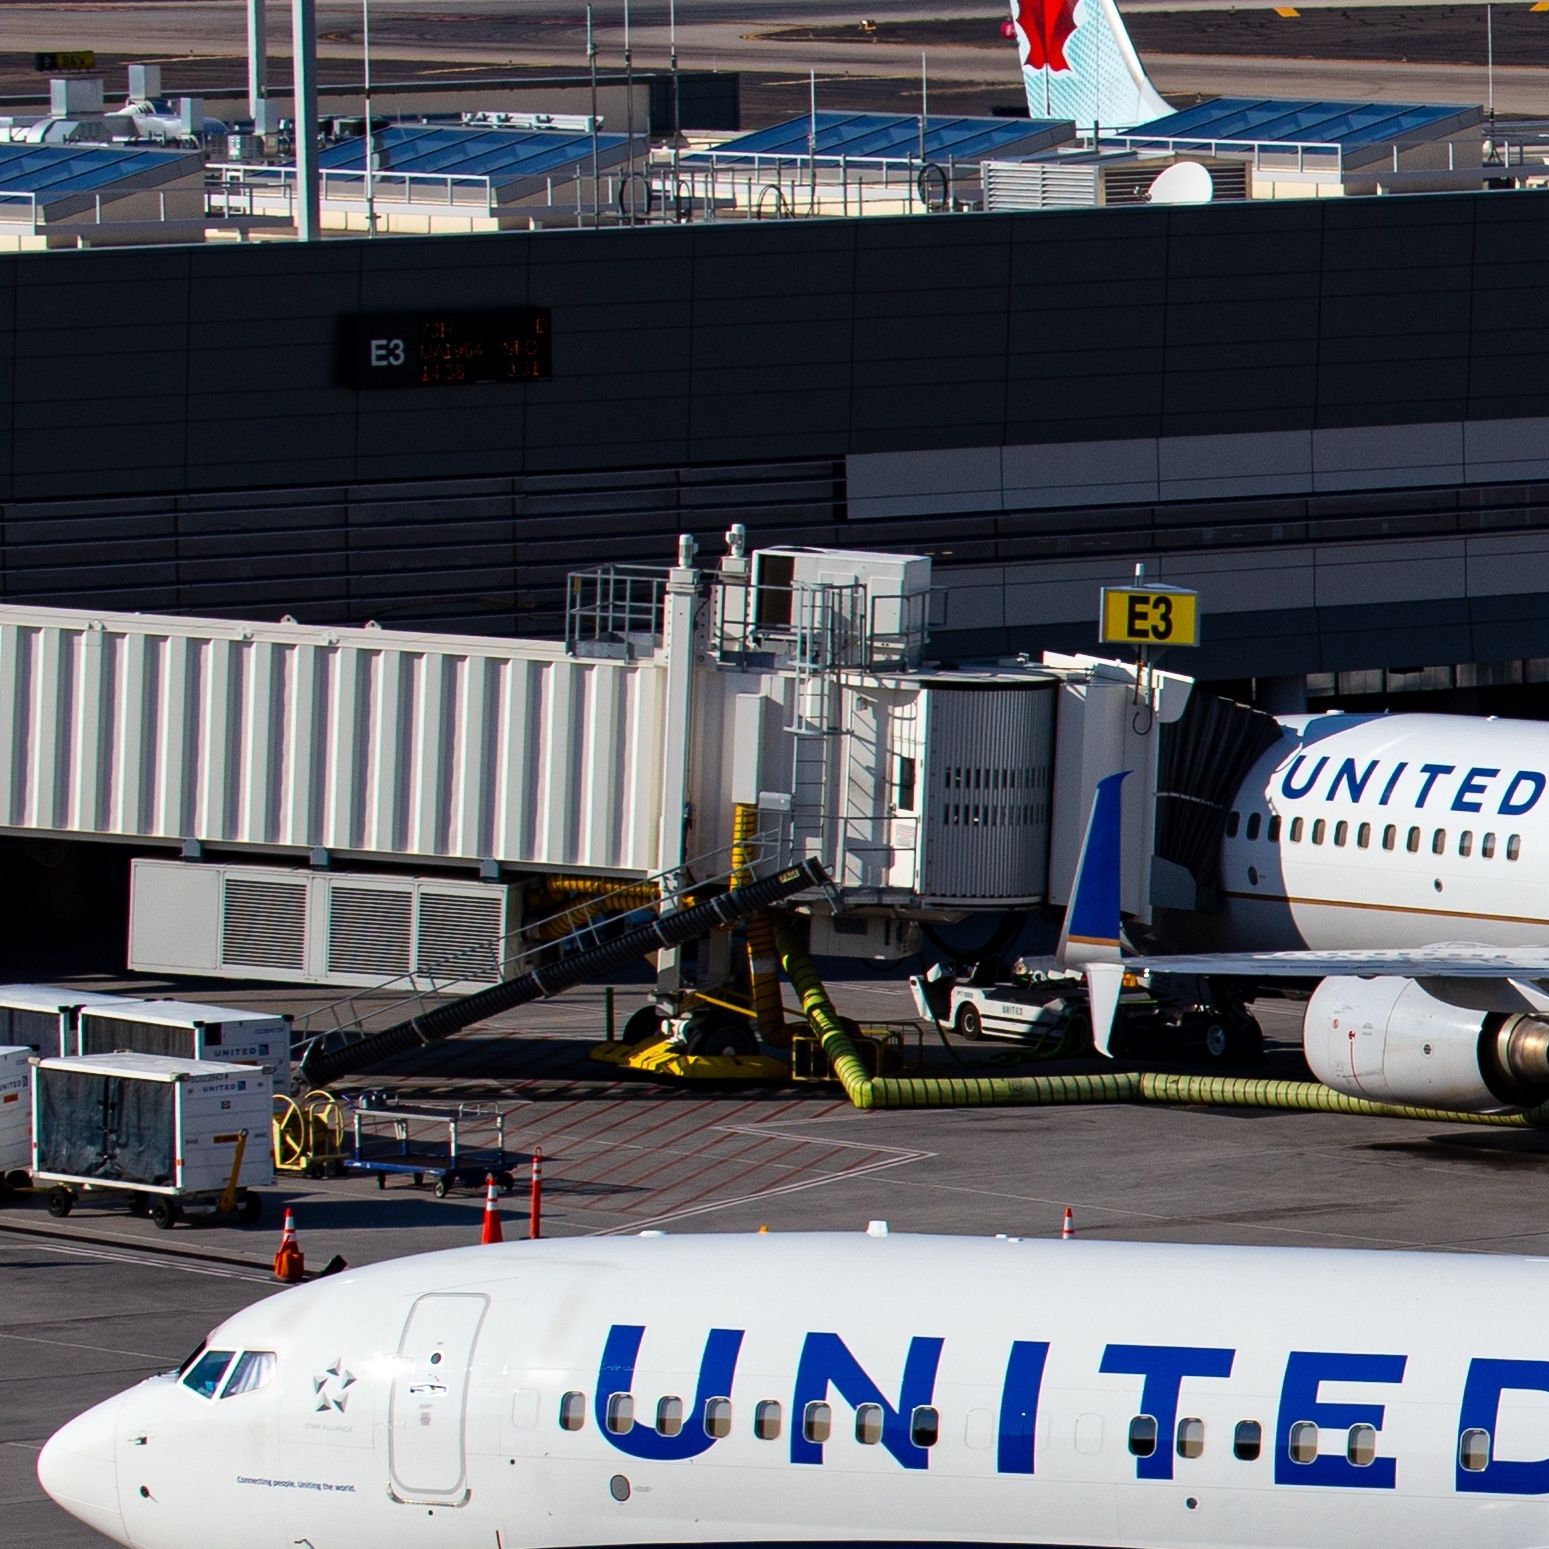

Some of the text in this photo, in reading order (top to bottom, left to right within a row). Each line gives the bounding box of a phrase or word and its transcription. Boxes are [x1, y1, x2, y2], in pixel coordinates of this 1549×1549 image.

[371, 339, 405, 366] E3
[1127, 596, 1173, 639] E3
[1281, 755, 1546, 816] UNITED
[214, 1048, 257, 1057] UNITED
[203, 1084, 236, 1093] UNITED
